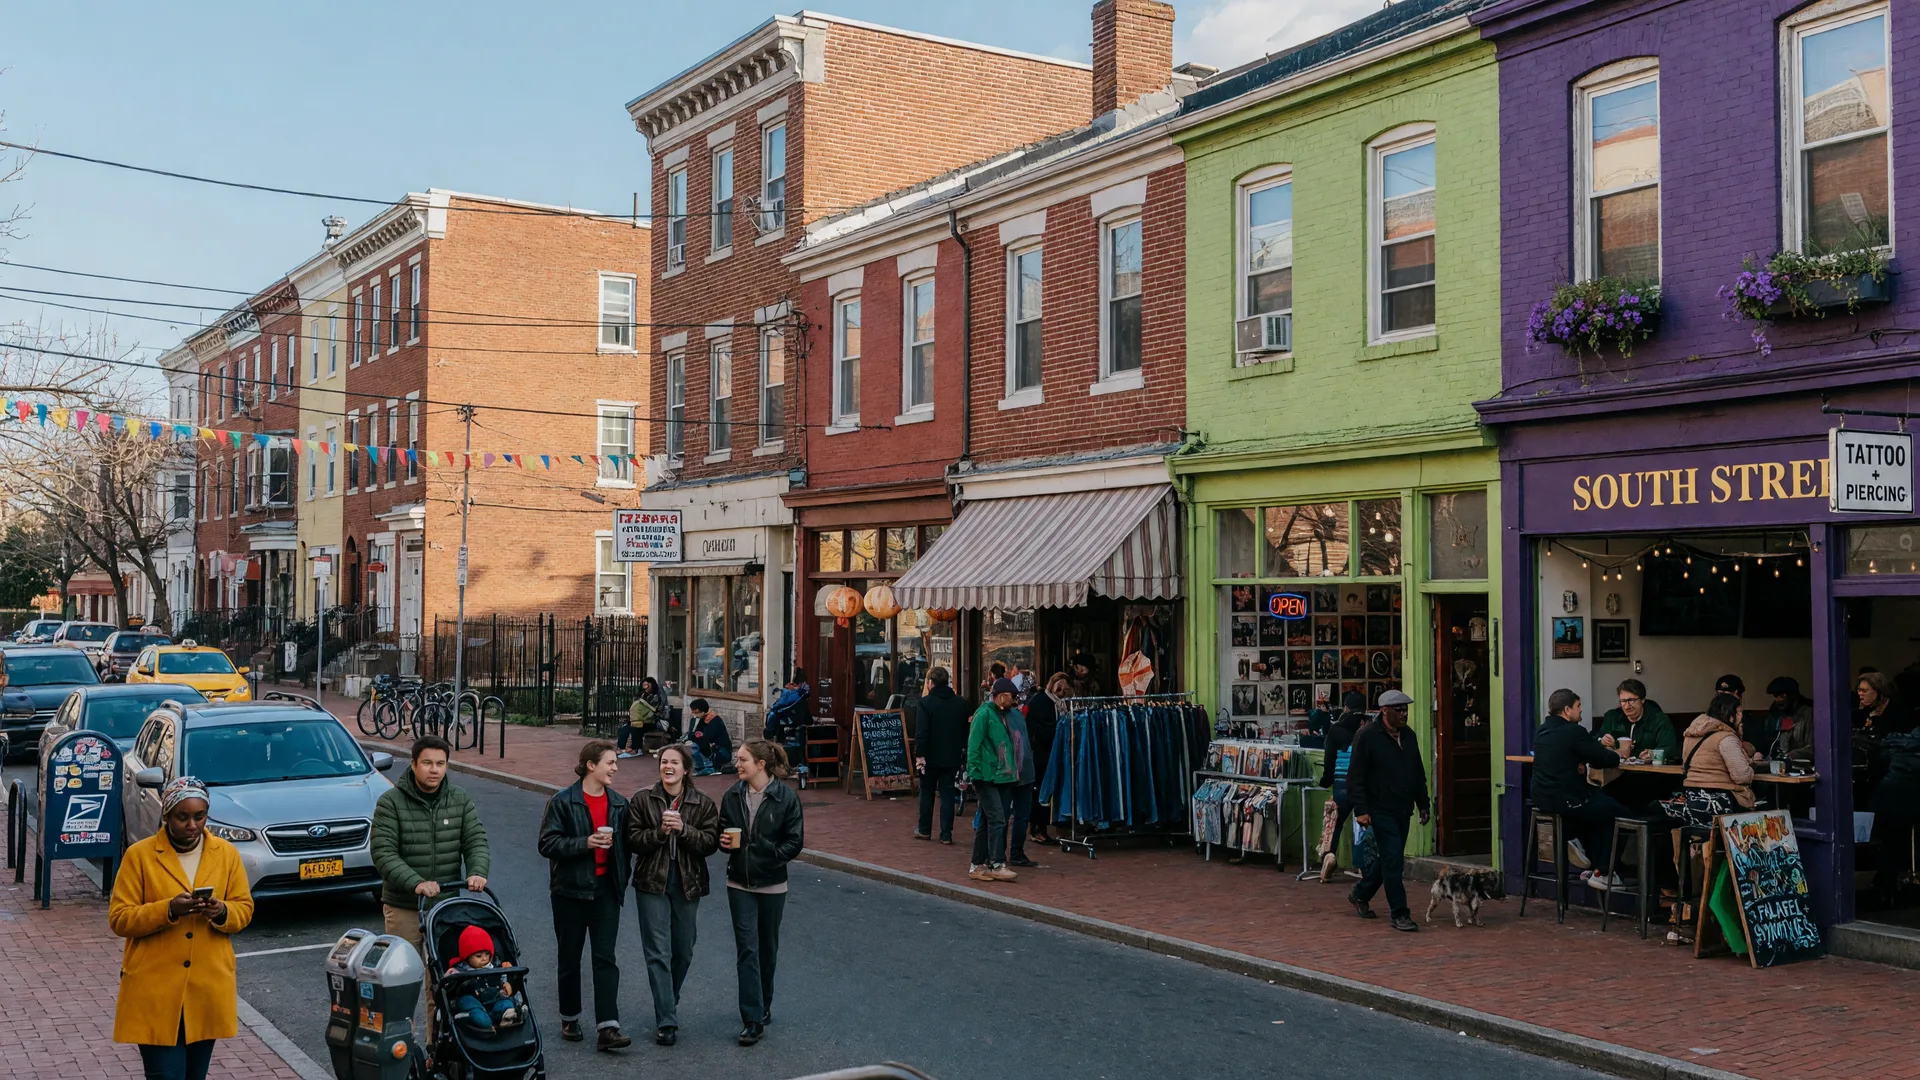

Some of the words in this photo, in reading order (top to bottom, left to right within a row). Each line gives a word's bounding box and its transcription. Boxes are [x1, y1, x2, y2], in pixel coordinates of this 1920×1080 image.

[1845, 443, 1906, 467] TATTOO
[1871, 469, 1881, 481] +
[1573, 467, 1700, 511] SOUTH
[1846, 484, 1907, 503] PIERCING
[1271, 597, 1305, 616] OPEN
[1757, 898, 1803, 921] FALAFEL
